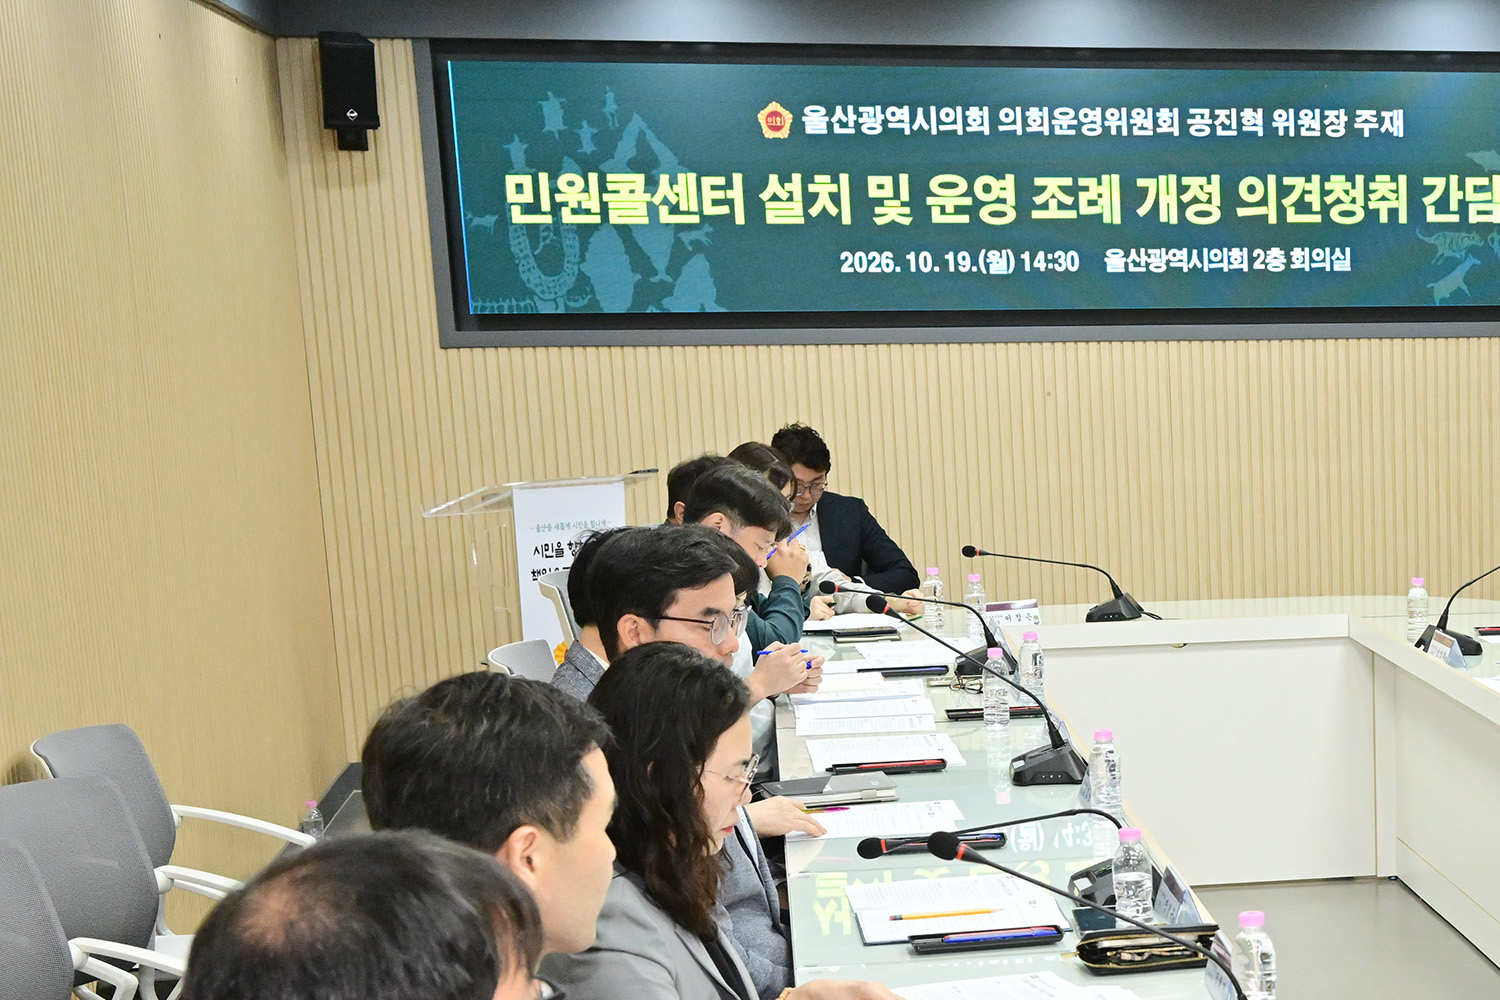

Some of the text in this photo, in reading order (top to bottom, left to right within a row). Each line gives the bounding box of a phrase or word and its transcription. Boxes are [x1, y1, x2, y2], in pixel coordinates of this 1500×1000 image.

[766, 115, 785, 127] 의회
[801, 104, 1404, 138] 울산광역시의회 의회운영위원회 공진혁 위원장 주재
[505, 172, 746, 225] 민원콜센터
[758, 172, 852, 225] 설치
[867, 173, 913, 226] 및
[925, 173, 1017, 226] 운영
[1031, 173, 1122, 225] 조례
[1136, 174, 1221, 225] 개정
[1236, 174, 1408, 225] 의견청취
[840, 247, 1352, 275] 2026. 10. 19.(월) 14:30 울산광역시의회 2층 회의실
[533, 541, 565, 559] 시민을
